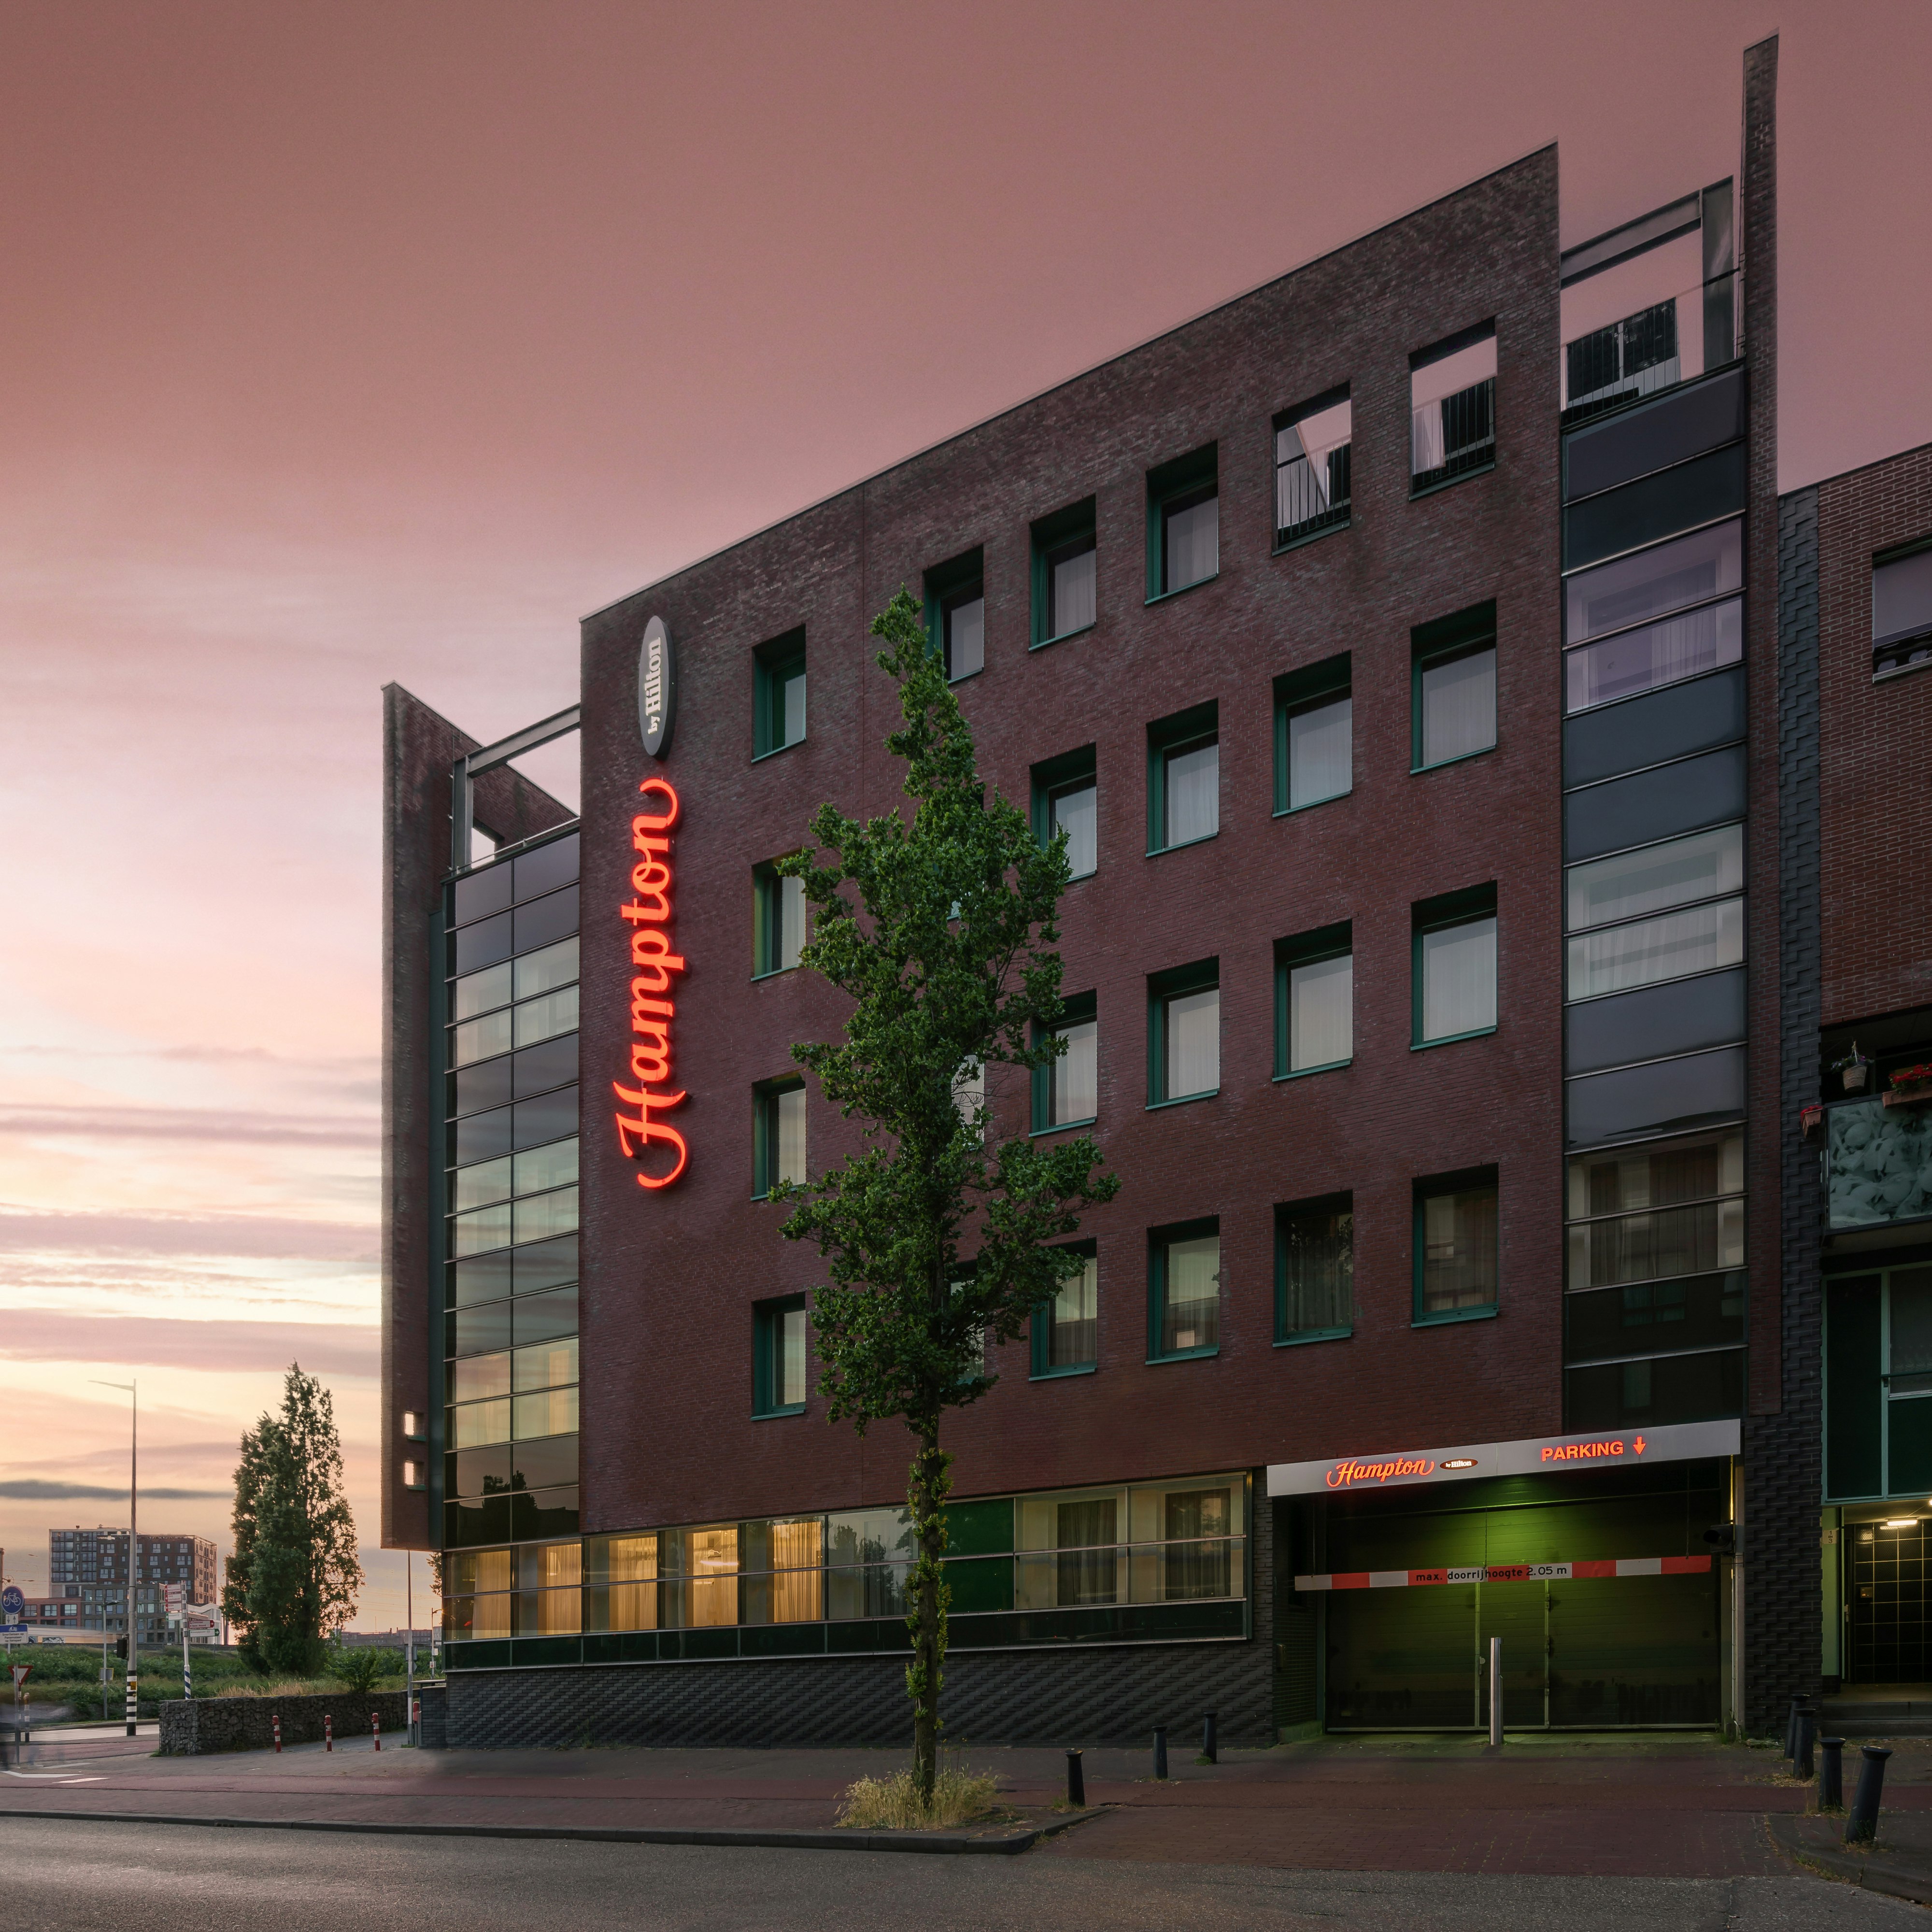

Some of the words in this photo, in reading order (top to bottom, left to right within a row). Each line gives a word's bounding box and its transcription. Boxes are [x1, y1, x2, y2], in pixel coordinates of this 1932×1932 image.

[644, 637, 661, 716] Hilton
[648, 716, 660, 734] by
[613, 778, 686, 1189] Hampton
[1541, 1440, 1624, 1462] PARKING
[1326, 1457, 1435, 1488] Hampton
[1416, 1573, 1443, 1581] max.
[1447, 1568, 1523, 1581] doorrijhoogte
[1526, 1566, 1553, 1576] 2.05
